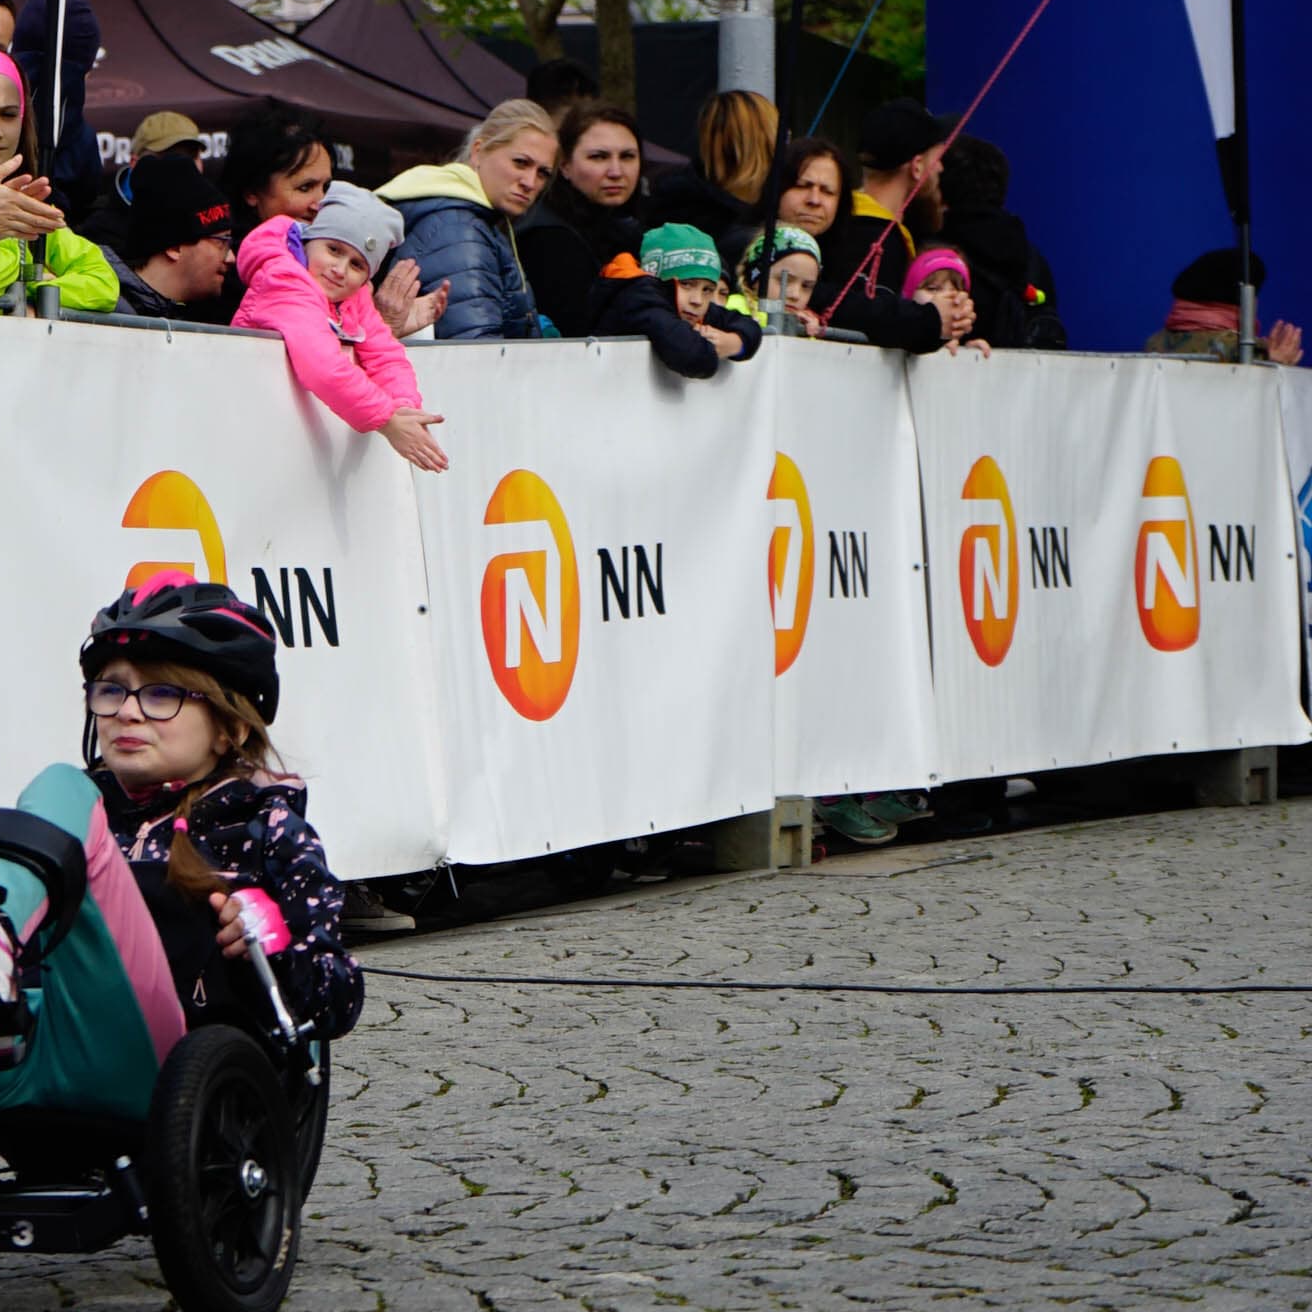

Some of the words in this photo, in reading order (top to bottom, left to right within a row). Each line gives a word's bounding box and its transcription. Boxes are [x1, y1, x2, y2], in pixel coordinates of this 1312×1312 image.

[597, 543, 666, 622] NN
[828, 531, 869, 599] NN
[1028, 527, 1072, 589] NN
[1208, 524, 1255, 582] NN
[251, 567, 339, 648] NN
